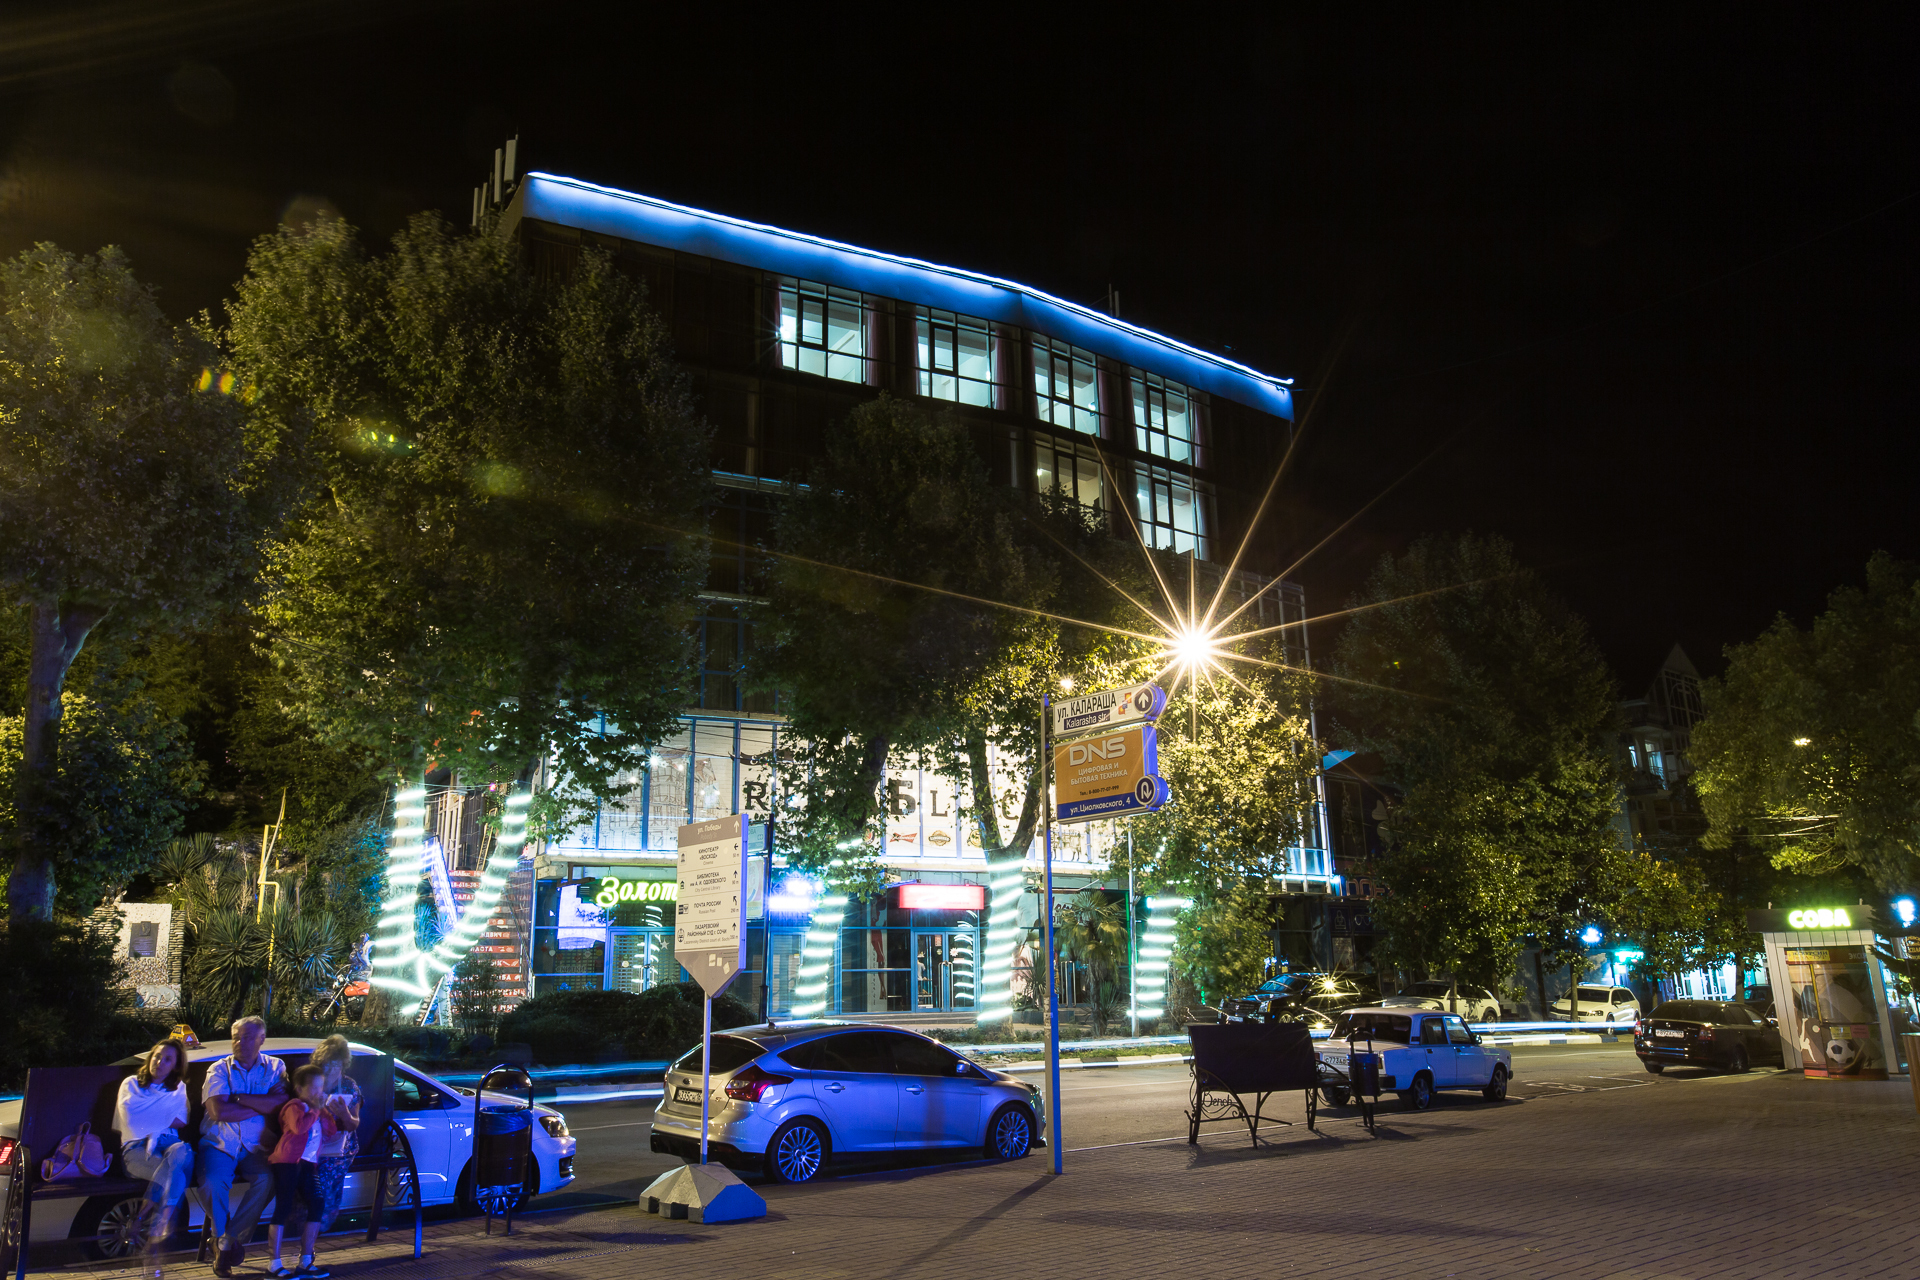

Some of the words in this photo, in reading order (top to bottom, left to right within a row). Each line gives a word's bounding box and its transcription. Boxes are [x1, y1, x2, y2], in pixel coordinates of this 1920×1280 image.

[1057, 707, 1069, 723] ул.
[1070, 692, 1117, 717] КАЛАРАША
[1066, 714, 1097, 729] Kalarasha
[1069, 736, 1126, 767] DNS
[1078, 764, 1113, 776] ЦИФРОВАЯ
[1070, 775, 1099, 786] БЫТОВАЯ
[1099, 769, 1128, 780] ТЕХНИКА
[1126, 796, 1131, 805] 4
[704, 824, 722, 832] Победы
[698, 846, 719, 854] КИНОТЕАТР
[696, 872, 720, 880] БИБЛИОТЕКА
[703, 877, 727, 885] ОДОЕВСКОГО
[596, 876, 678, 908] Золот
[1788, 908, 1852, 929] СОВА
[695, 922, 720, 930] ЛАЗАРЕВСКИЙ
[687, 929, 707, 937] РАЙОННЫЙ
